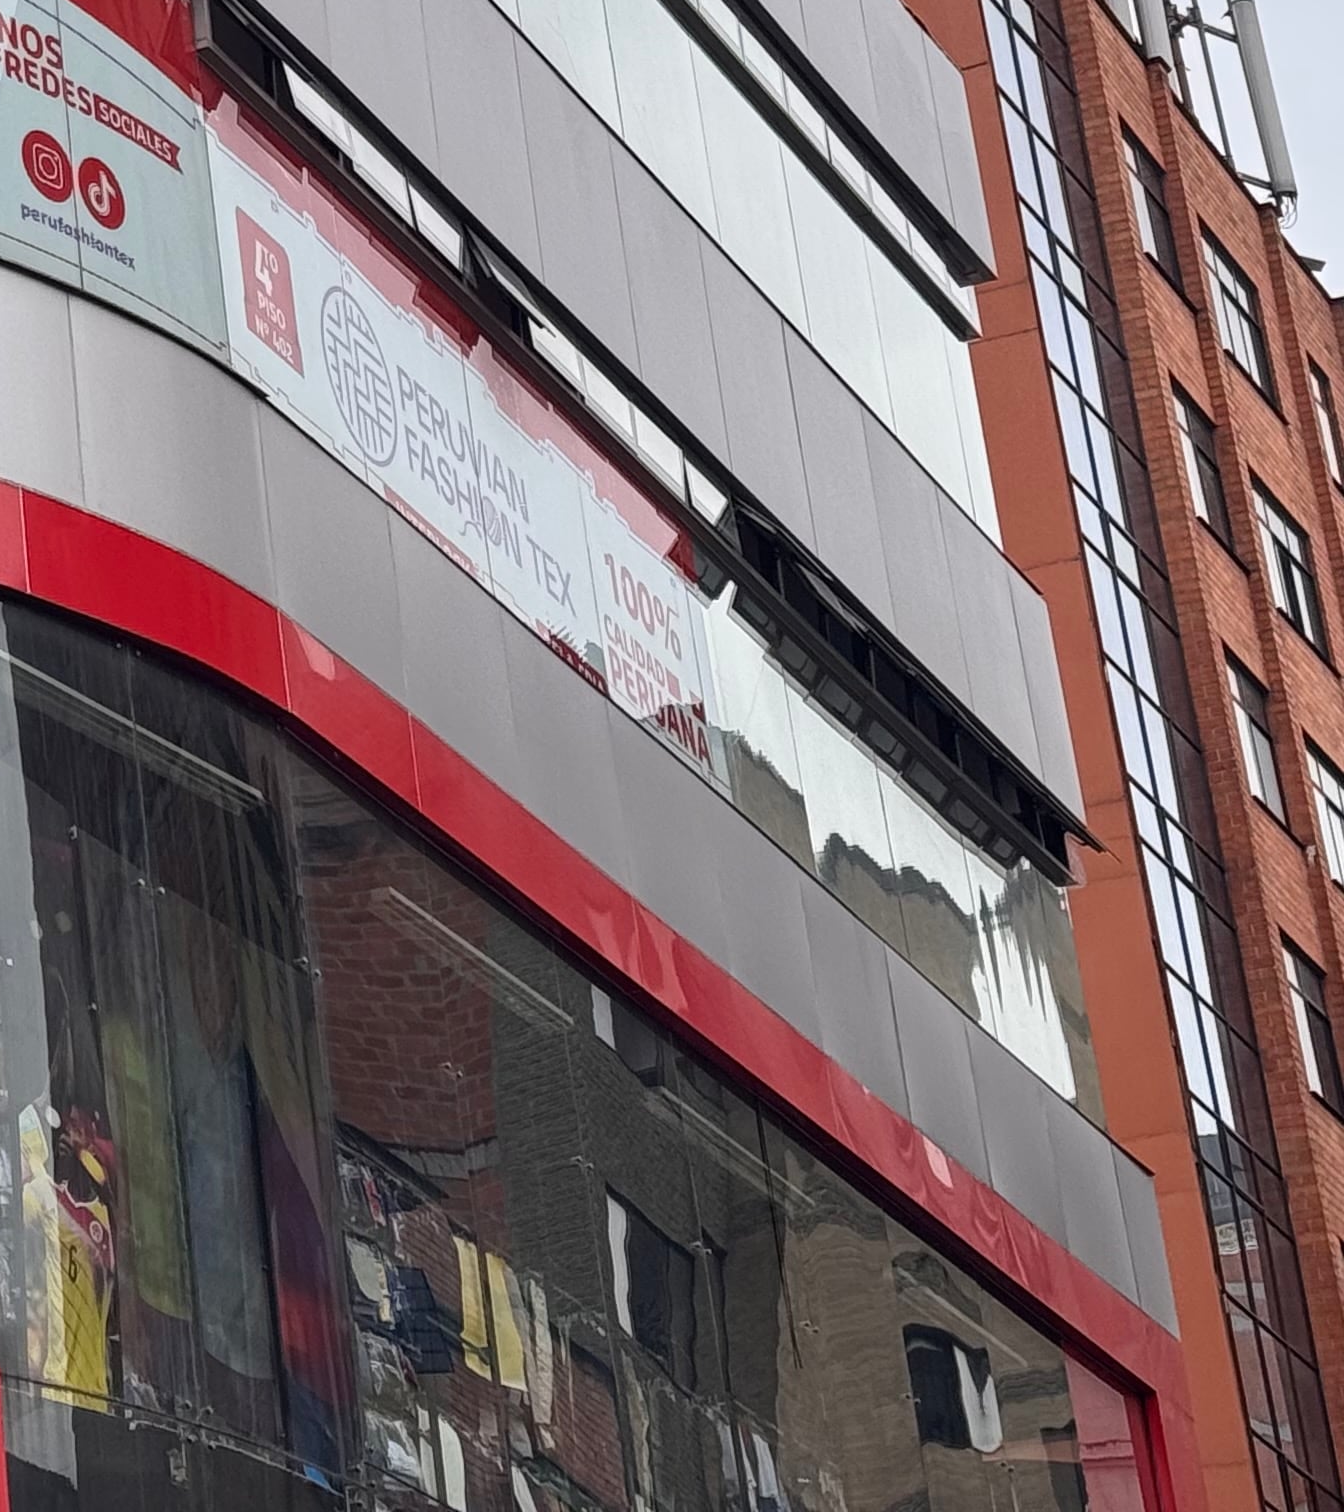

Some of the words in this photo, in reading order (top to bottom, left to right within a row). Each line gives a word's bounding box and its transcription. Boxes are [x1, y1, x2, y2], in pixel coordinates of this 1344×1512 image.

[4, 50, 93, 117] REDES
[99, 101, 173, 163] SOCIALES
[257, 289, 287, 330] PISO
[272, 331, 295, 366] 402
[396, 364, 530, 525] PERUVIAN
[404, 423, 524, 570] FASHION
[525, 533, 578, 618] TEX
[604, 553, 683, 662] 100%
[604, 614, 666, 689] CALIDAD
[607, 644, 715, 773] PERUANA
[68, 1244, 78, 1284] 6
